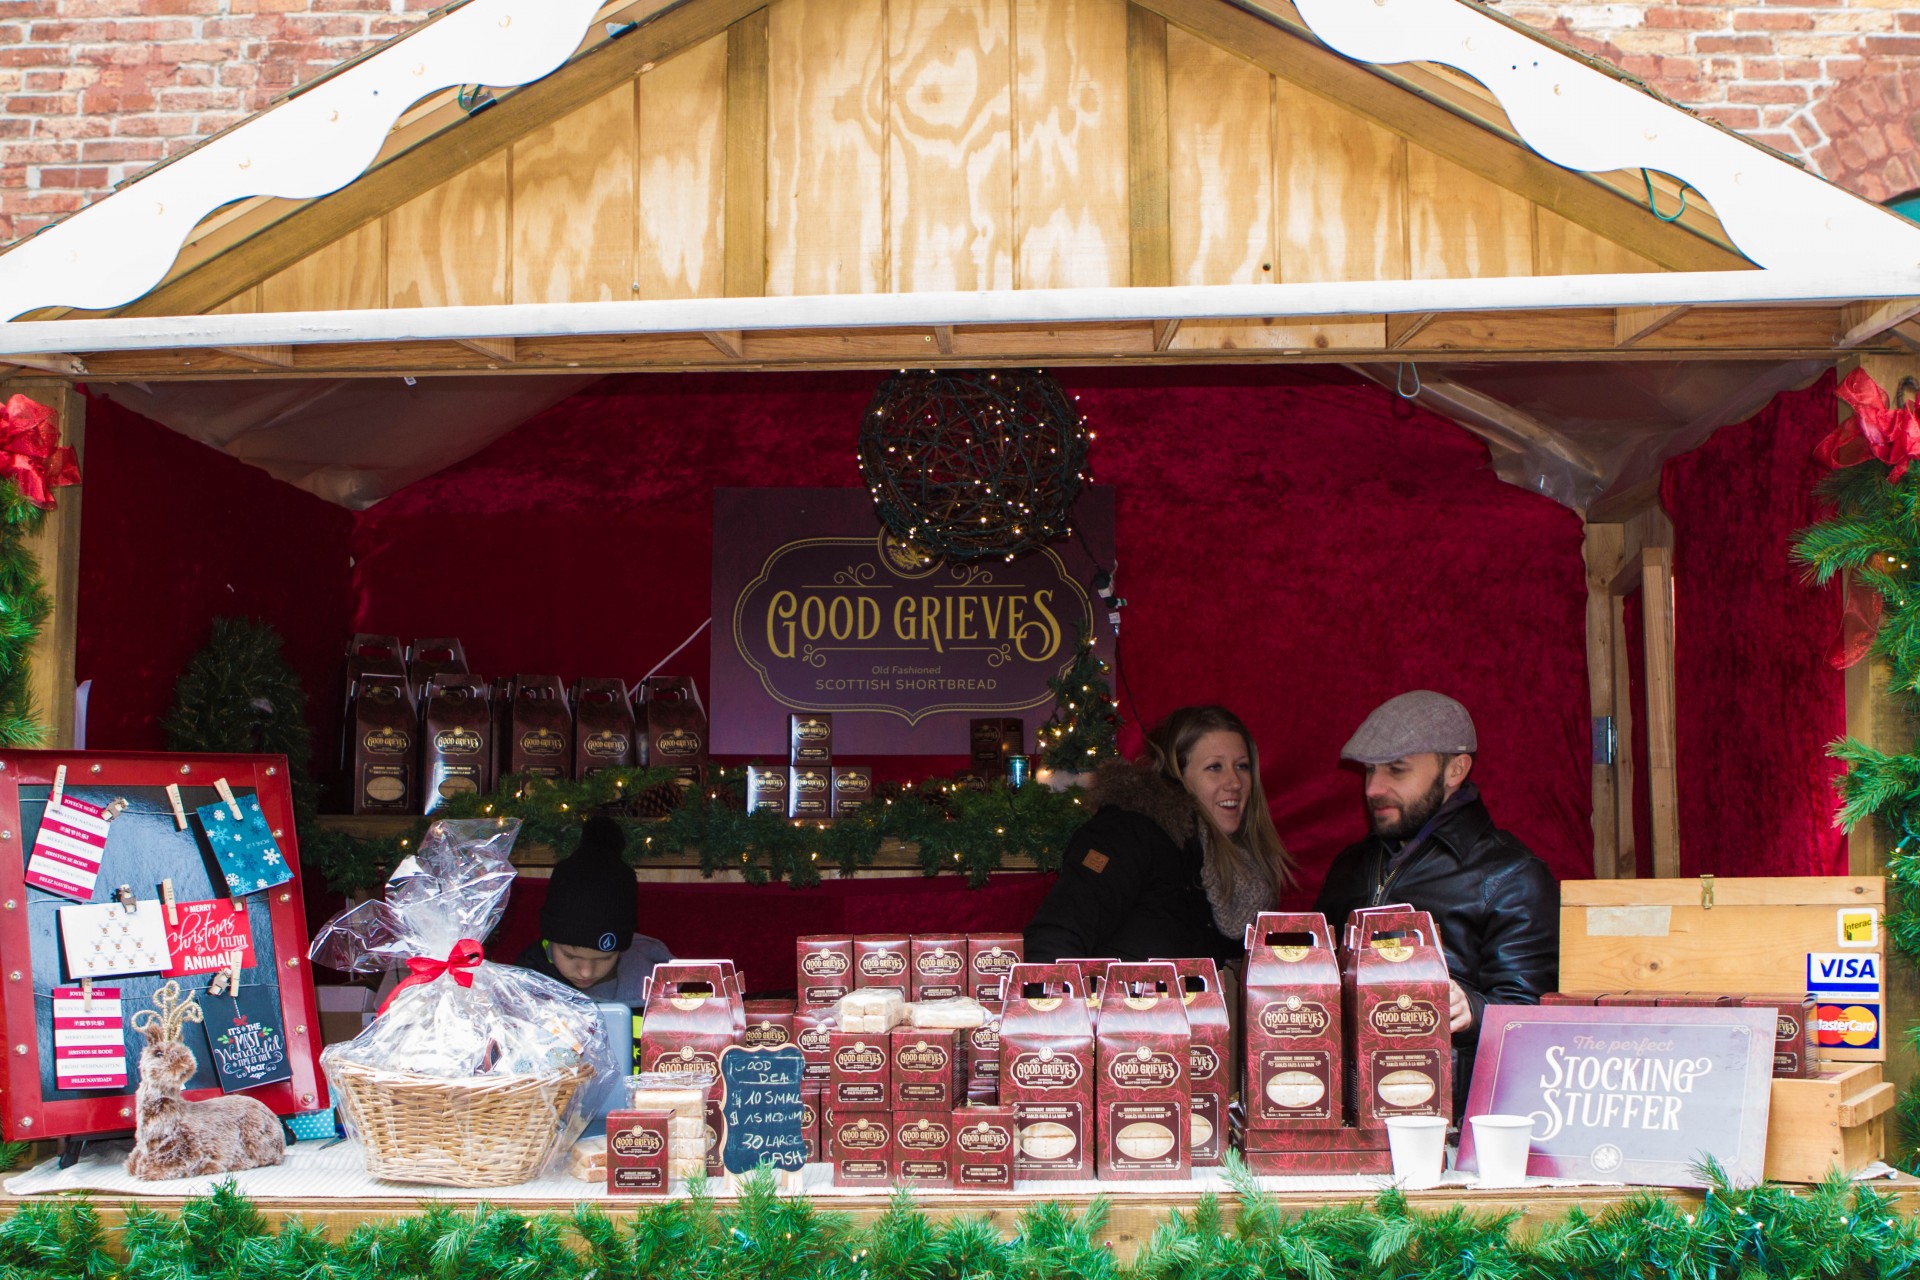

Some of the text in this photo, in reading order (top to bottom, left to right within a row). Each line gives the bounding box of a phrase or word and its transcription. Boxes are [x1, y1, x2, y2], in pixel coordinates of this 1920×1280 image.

[767, 589, 1061, 662] GOOD GRIEVES
[871, 665, 941, 675] Old Fashioned
[815, 679, 997, 690] SCOTTISH SHORTBREAD
[189, 904, 212, 913] MERRY
[1844, 919, 1871, 932] Interac
[184, 951, 232, 971] ANIMAL
[1819, 959, 1875, 978] VISA
[1265, 1011, 1324, 1027] GOOD GRIEVES
[1375, 1010, 1434, 1026] GOOD GRIEVES
[228, 1022, 262, 1036] IT'S THE
[214, 1035, 283, 1064] Wonderful
[1574, 1035, 1675, 1056] The perfect
[839, 1053, 881, 1065] GOOD GRIEVES
[901, 1052, 943, 1065] GOOD GRIEVES
[245, 1063, 266, 1073] Year
[660, 1061, 717, 1079] GOOD GRIEVES
[1017, 1063, 1040, 1078] GOOD
[1042, 1063, 1076, 1079] GRIEVES
[1115, 1062, 1175, 1079] GOOD GRIEVES
[1540, 1046, 1712, 1093] STOCKING
[744, 1090, 762, 1105] 10
[765, 1091, 803, 1105] SMALL
[1529, 1088, 1683, 1141] STUFFER
[616, 1137, 660, 1150] GOOD GRIEVES
[765, 1135, 802, 1148] LARGE
[842, 1130, 885, 1143] GOOD GRIEVES
[902, 1130, 944, 1143] GOOD GRIEVES
[962, 1133, 1005, 1146] GOOD GRIEVES
[760, 1151, 804, 1166] CASH
